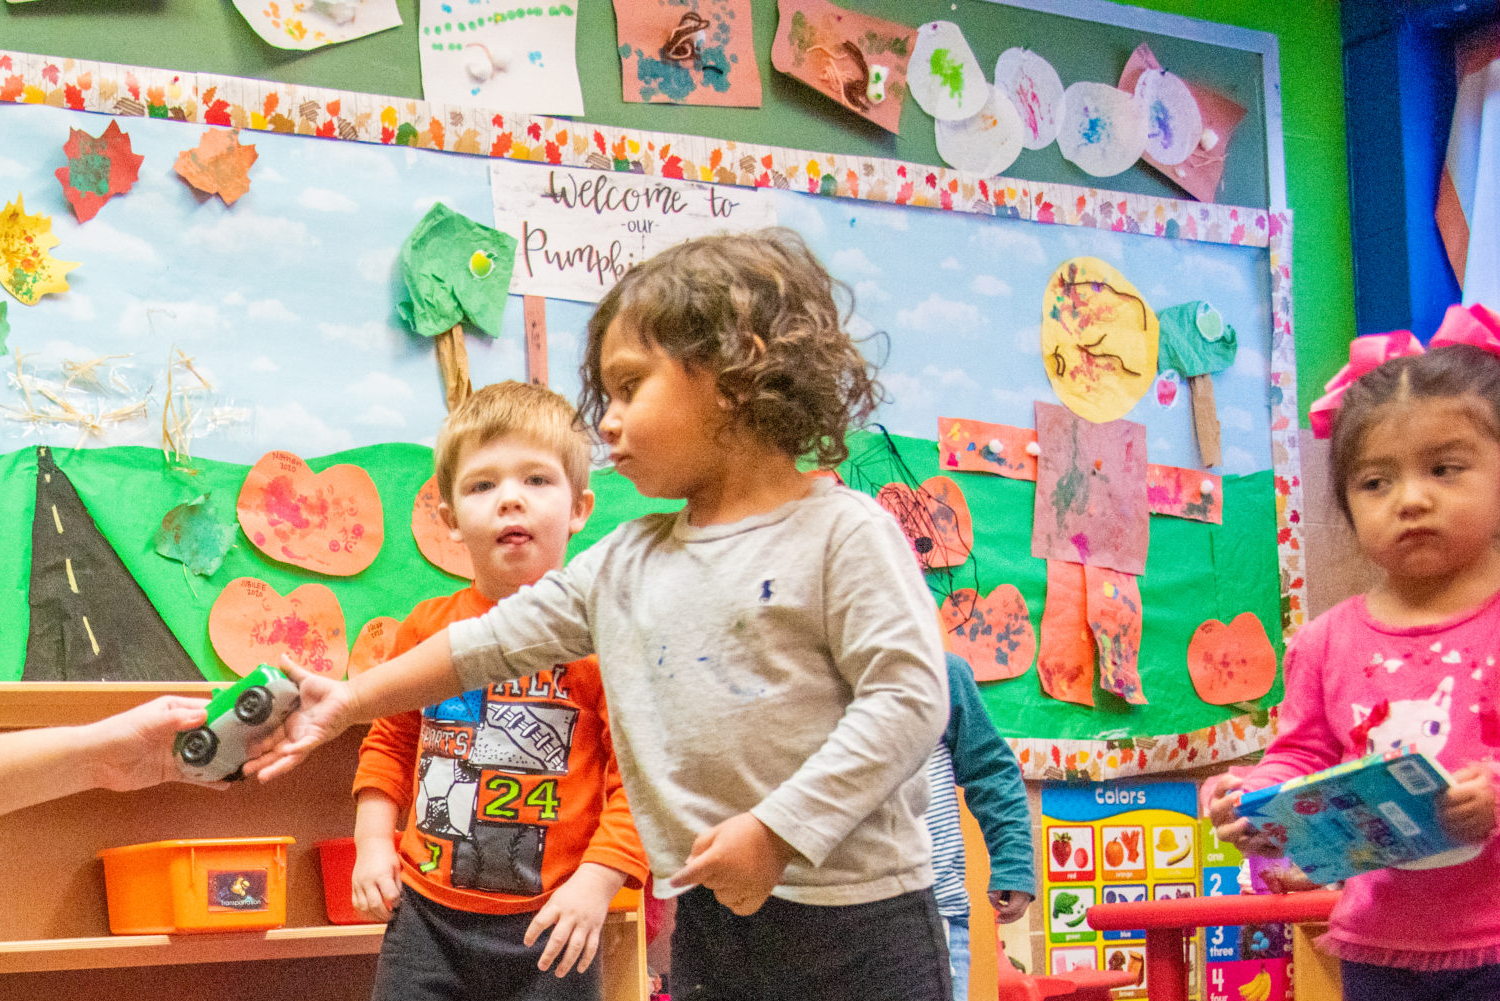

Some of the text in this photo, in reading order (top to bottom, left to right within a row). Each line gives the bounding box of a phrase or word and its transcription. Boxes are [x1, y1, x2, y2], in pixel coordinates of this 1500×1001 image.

[541, 170, 740, 218] Welcome to
[484, 775, 561, 822] 24
[1095, 787, 1146, 805] Colors
[1209, 826, 1219, 849] 1
[1207, 853, 1224, 863] one
[1067, 872, 1076, 880] red
[1210, 873, 1223, 896] 2
[220, 899, 262, 907] Transportation
[1211, 925, 1224, 945] 3
[1210, 945, 1233, 957] three
[1211, 968, 1224, 993] 4
